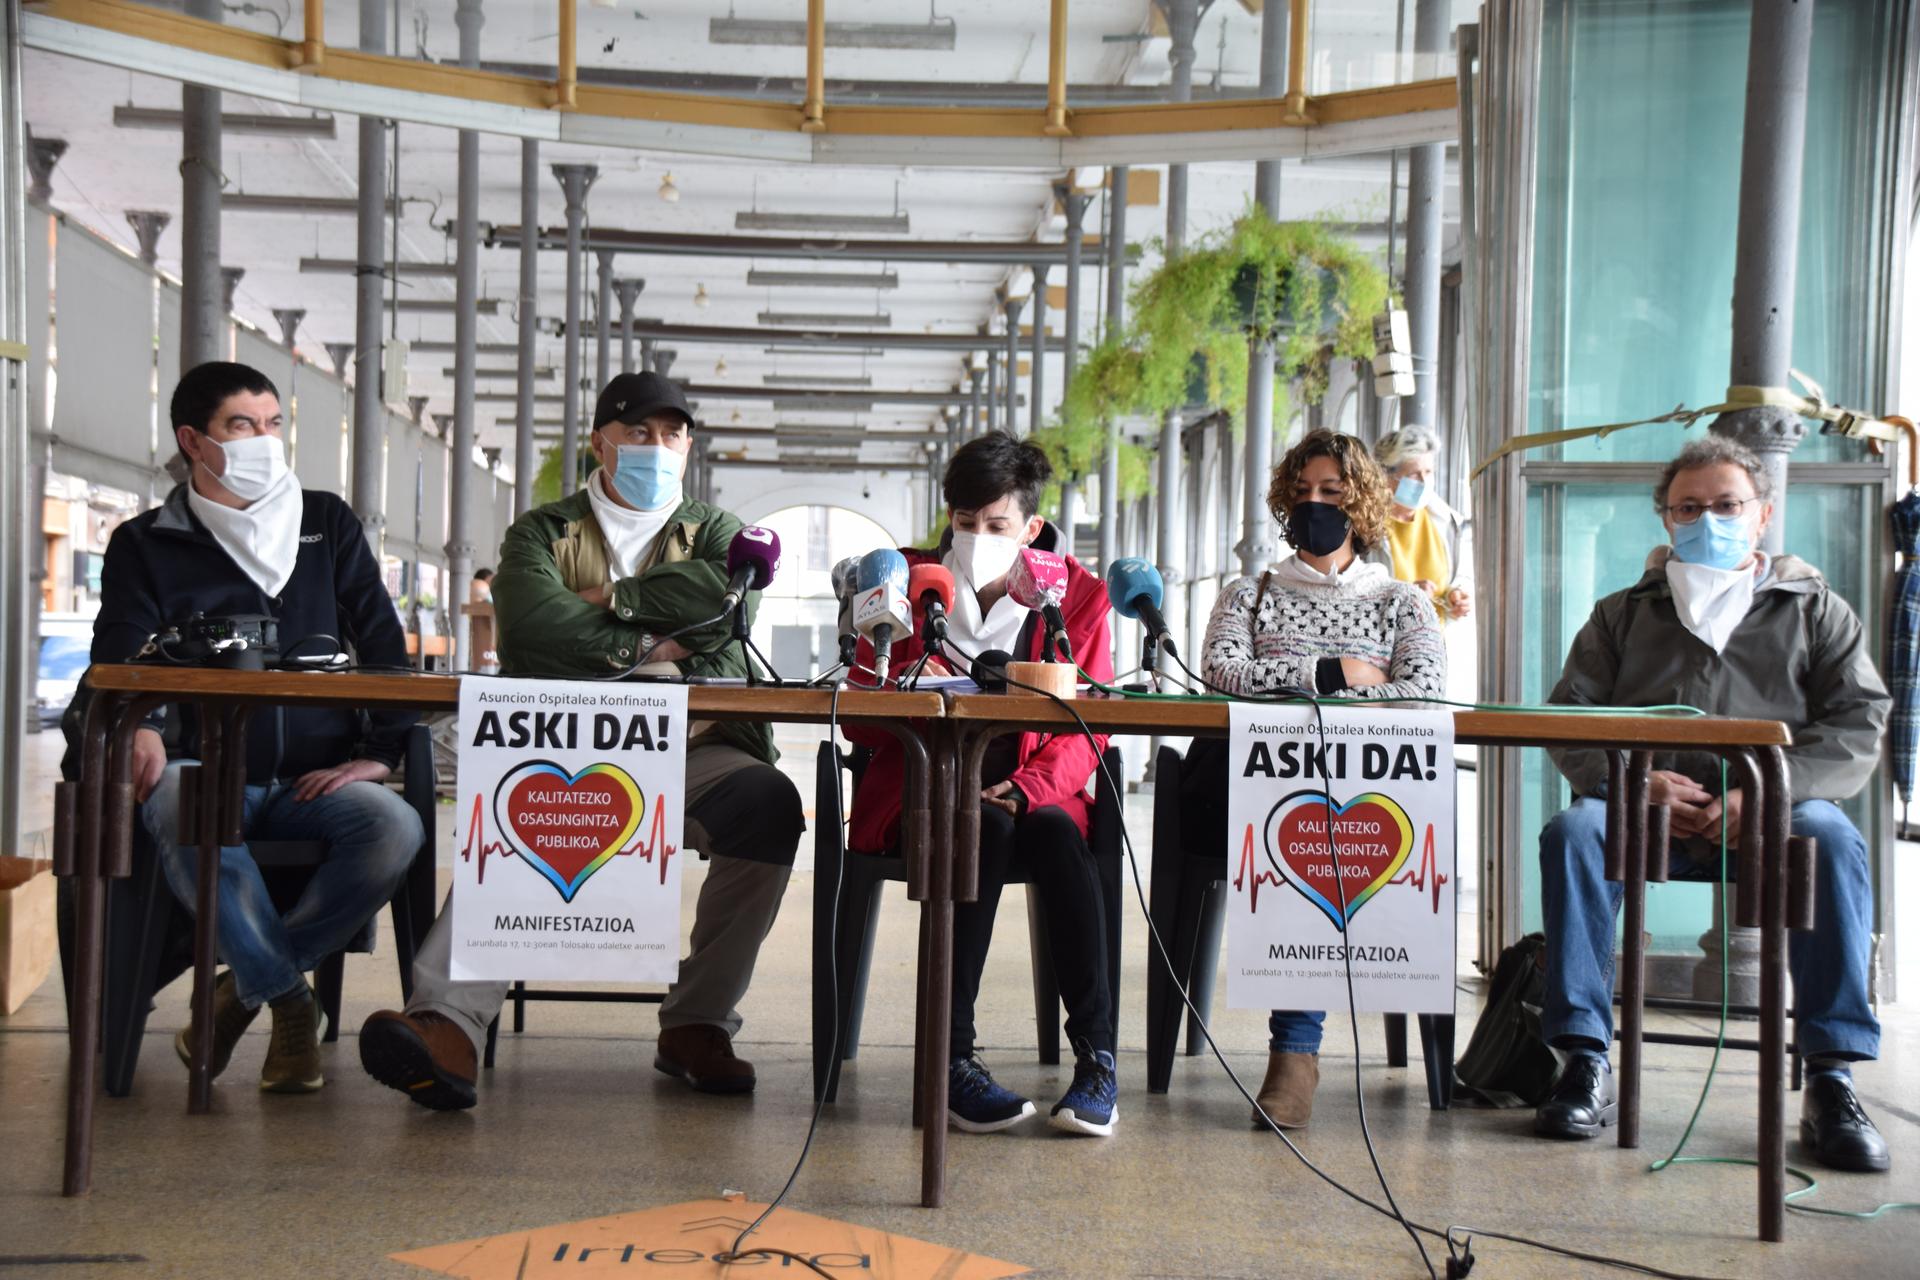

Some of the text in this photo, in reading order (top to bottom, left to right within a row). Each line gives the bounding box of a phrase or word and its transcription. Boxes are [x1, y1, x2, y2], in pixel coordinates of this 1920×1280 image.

[478, 692, 667, 707] Asuncion Ospitalea Konfinatua
[472, 710, 670, 752] ASKI DA!
[1248, 723, 1304, 734] Asuncion
[1367, 724, 1434, 737] Konfinatua
[1243, 741, 1437, 781] ASKI DA!
[527, 790, 612, 805] KALITATEZKO
[518, 812, 620, 827] OSASUNGINTZA
[1298, 820, 1380, 834] KALIATEZKO
[536, 834, 600, 848] PUBLIKOA
[1307, 864, 1371, 878] PUBIKOA
[494, 915, 635, 933] MANIFESTAZIOA
[466, 938, 508, 948] Larunbata
[560, 939, 596, 950] Tolosako
[597, 940, 632, 950] udaletxe
[634, 942, 666, 951] aurrean
[1268, 944, 1409, 962] MANIFESTAZIOA
[1241, 967, 1282, 977] Larunbata
[1334, 968, 1370, 979] Tolsako
[1371, 969, 1407, 980] udaletxe
[1408, 971, 1441, 981] aurrean
[553, 1243, 870, 1269] Irteera
